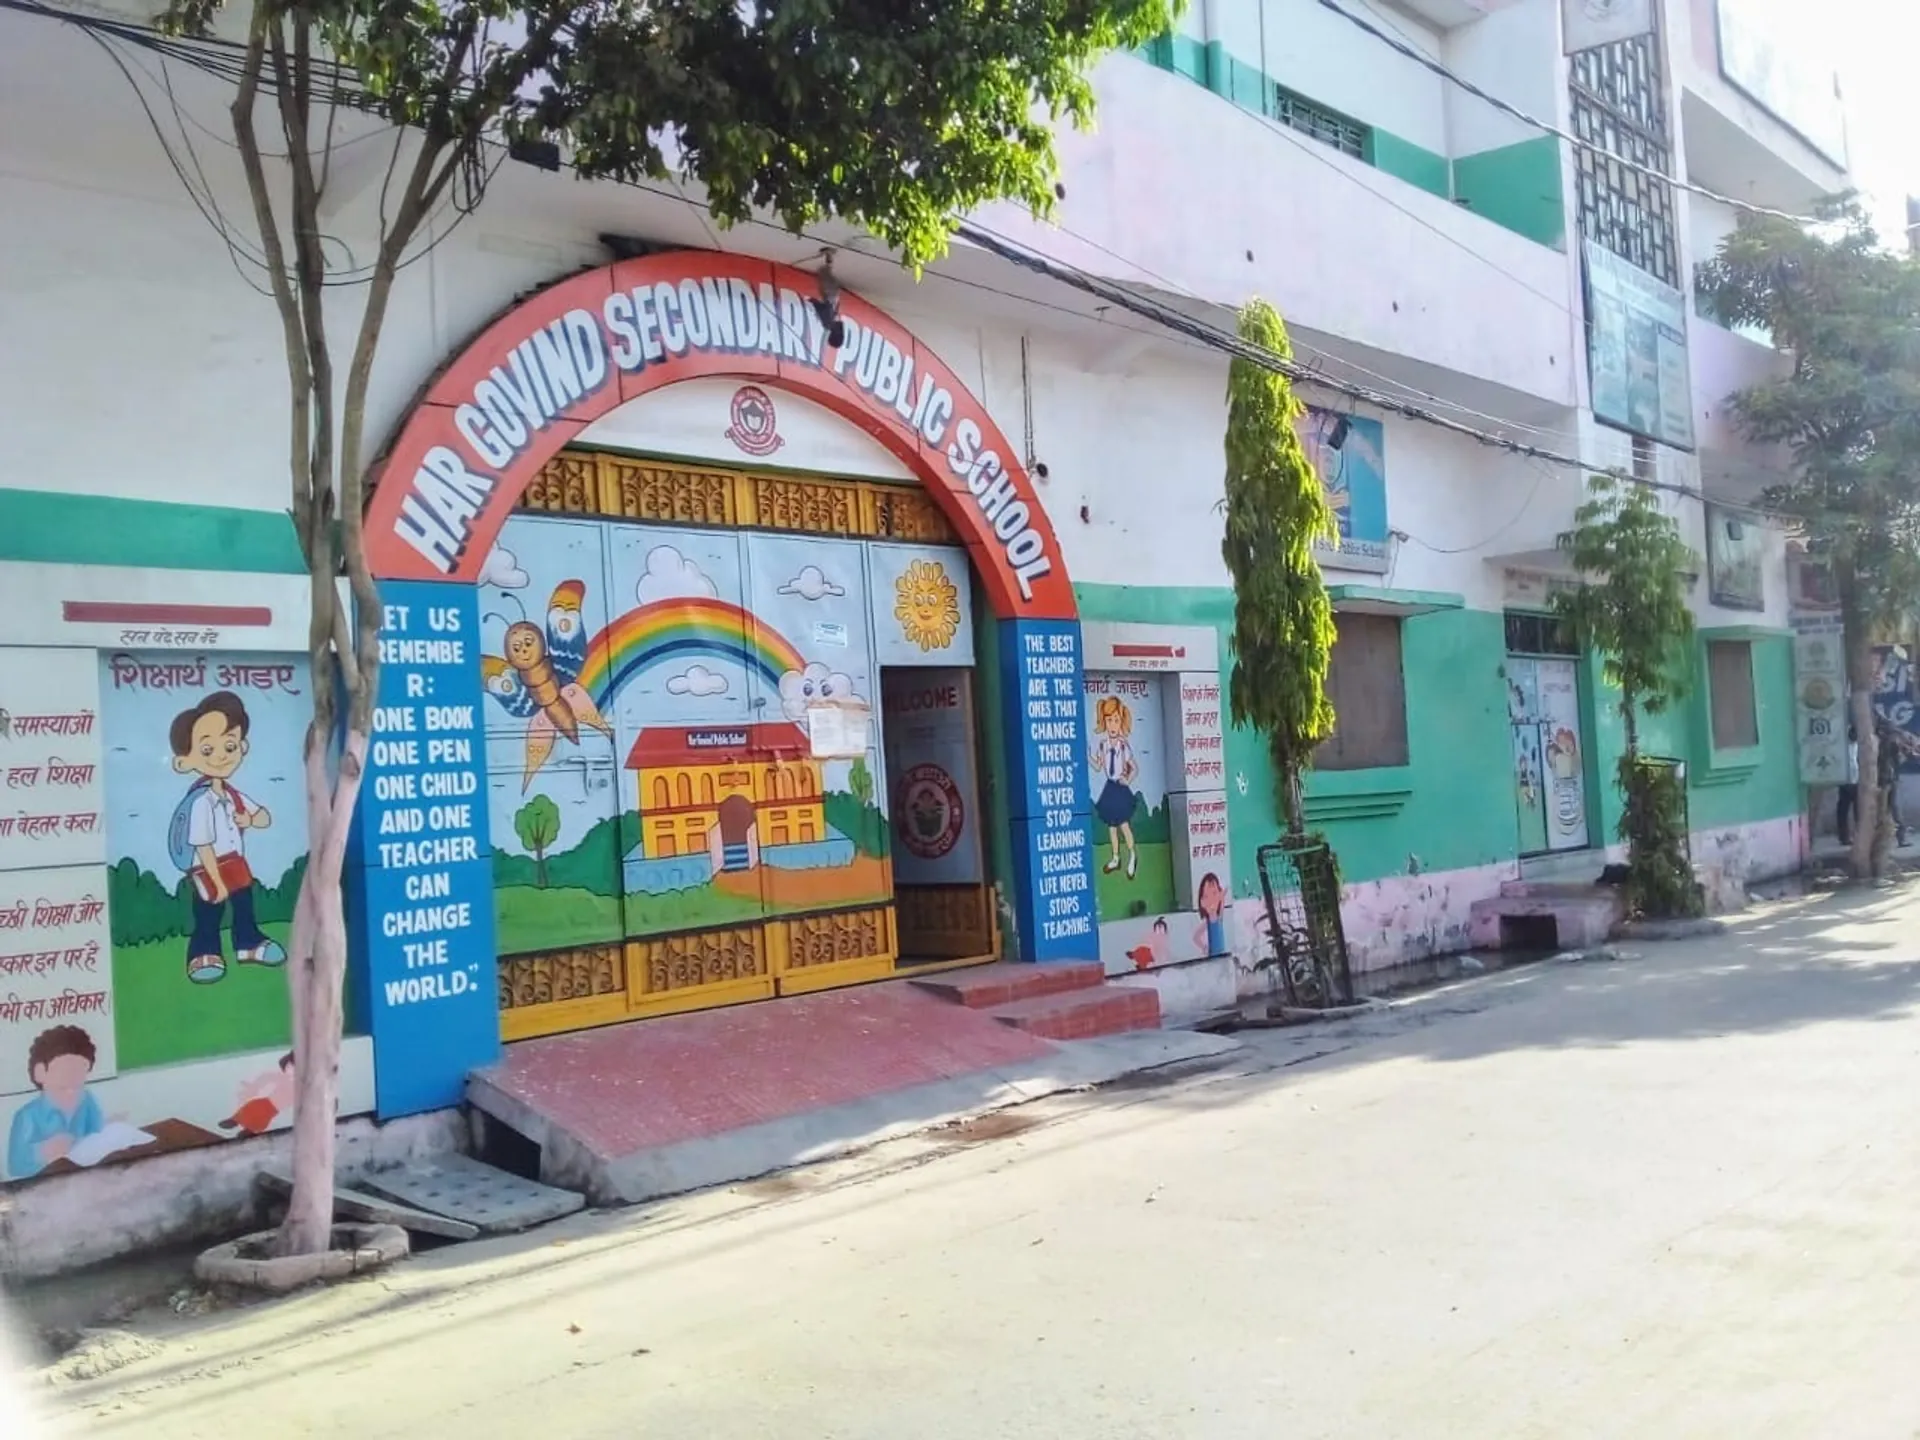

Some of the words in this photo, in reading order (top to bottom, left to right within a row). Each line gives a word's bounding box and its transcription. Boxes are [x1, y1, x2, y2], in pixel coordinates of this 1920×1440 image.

[393, 446, 494, 575] HAR
[454, 308, 610, 471] GOVIND
[603, 276, 840, 373] SECONDARY
[834, 316, 953, 444] PUBLIC
[947, 417, 1051, 602] SCHOOL
[380, 606, 409, 631] ET
[428, 608, 461, 632] US
[1024, 633, 1045, 652] THE
[1049, 634, 1074, 653] BEST
[1026, 655, 1075, 674] TEACHERS
[407, 673, 435, 697] R:
[1028, 678, 1048, 697] ARE
[1054, 678, 1074, 696] THE
[886, 687, 957, 713] ELCOME
[1028, 700, 1051, 718] ONES
[1054, 699, 1077, 718] THAT
[372, 707, 417, 732] ONE
[424, 705, 474, 731] BOOK
[1031, 721, 1077, 740] CHANGE
[373, 741, 420, 766] ONE
[428, 739, 472, 764] PEN
[1038, 743, 1072, 763] THEIR
[7, 766, 41, 790] हल
[47, 755, 96, 790] शिक्षा
[375, 774, 418, 800] ONE
[420, 771, 477, 797] CHILD
[379, 807, 425, 834] AND
[428, 804, 472, 831] ONE
[1045, 808, 1073, 829] STOP
[378, 836, 479, 869] TEACHER
[1036, 830, 1085, 852] LEARNING
[1042, 850, 1083, 874] BECAUSE
[405, 872, 451, 901] CAN
[1039, 876, 1058, 896] LIFE
[1060, 872, 1087, 894] NEVER
[31, 897, 76, 932] शिक्षा
[74, 894, 105, 925] और
[383, 903, 471, 937] CHANGE
[1049, 896, 1080, 918] STOPS
[63, 949, 84, 971] पर
[84, 939, 102, 973] है
[403, 939, 449, 969] THE
[0, 992, 22, 1023] भी
[24, 999, 45, 1021] का
